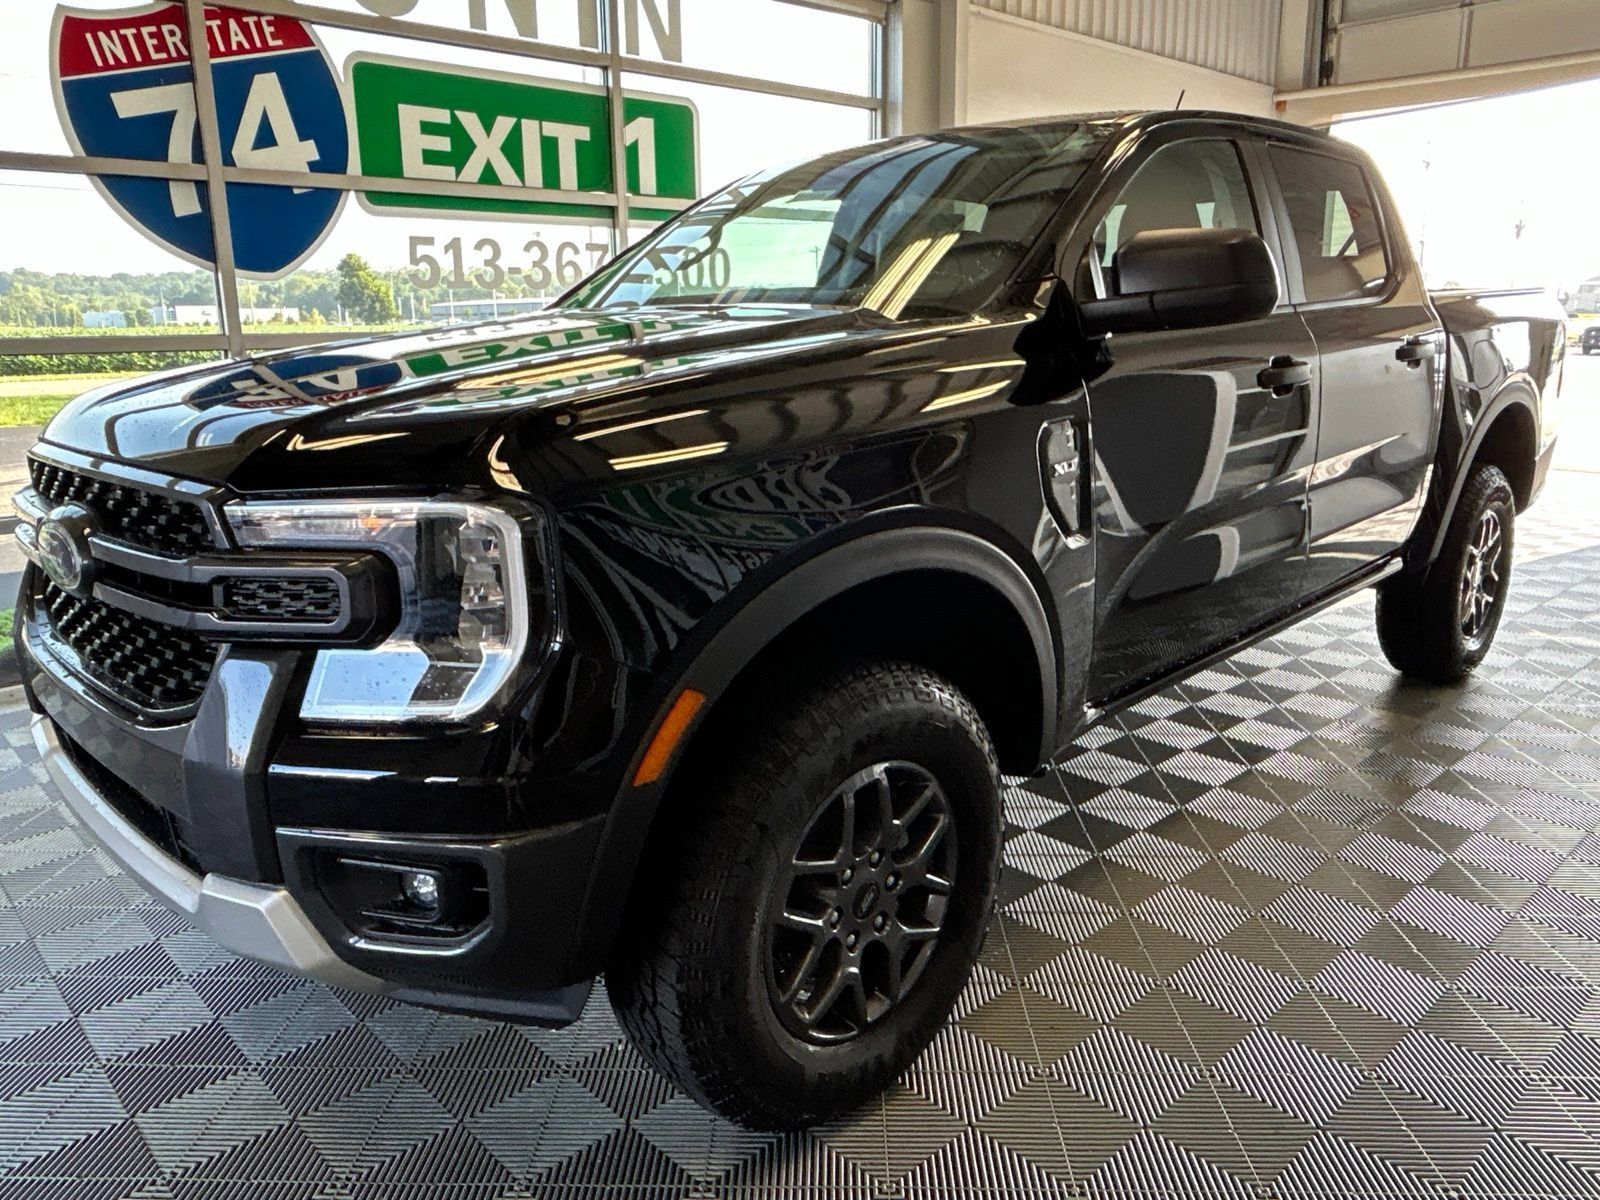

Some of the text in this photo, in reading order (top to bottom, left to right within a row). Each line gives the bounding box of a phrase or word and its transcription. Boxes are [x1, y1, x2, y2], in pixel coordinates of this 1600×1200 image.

[85, 15, 284, 68] INTERTATE
[110, 71, 321, 218] 74
[397, 102, 658, 196] EXIT 1
